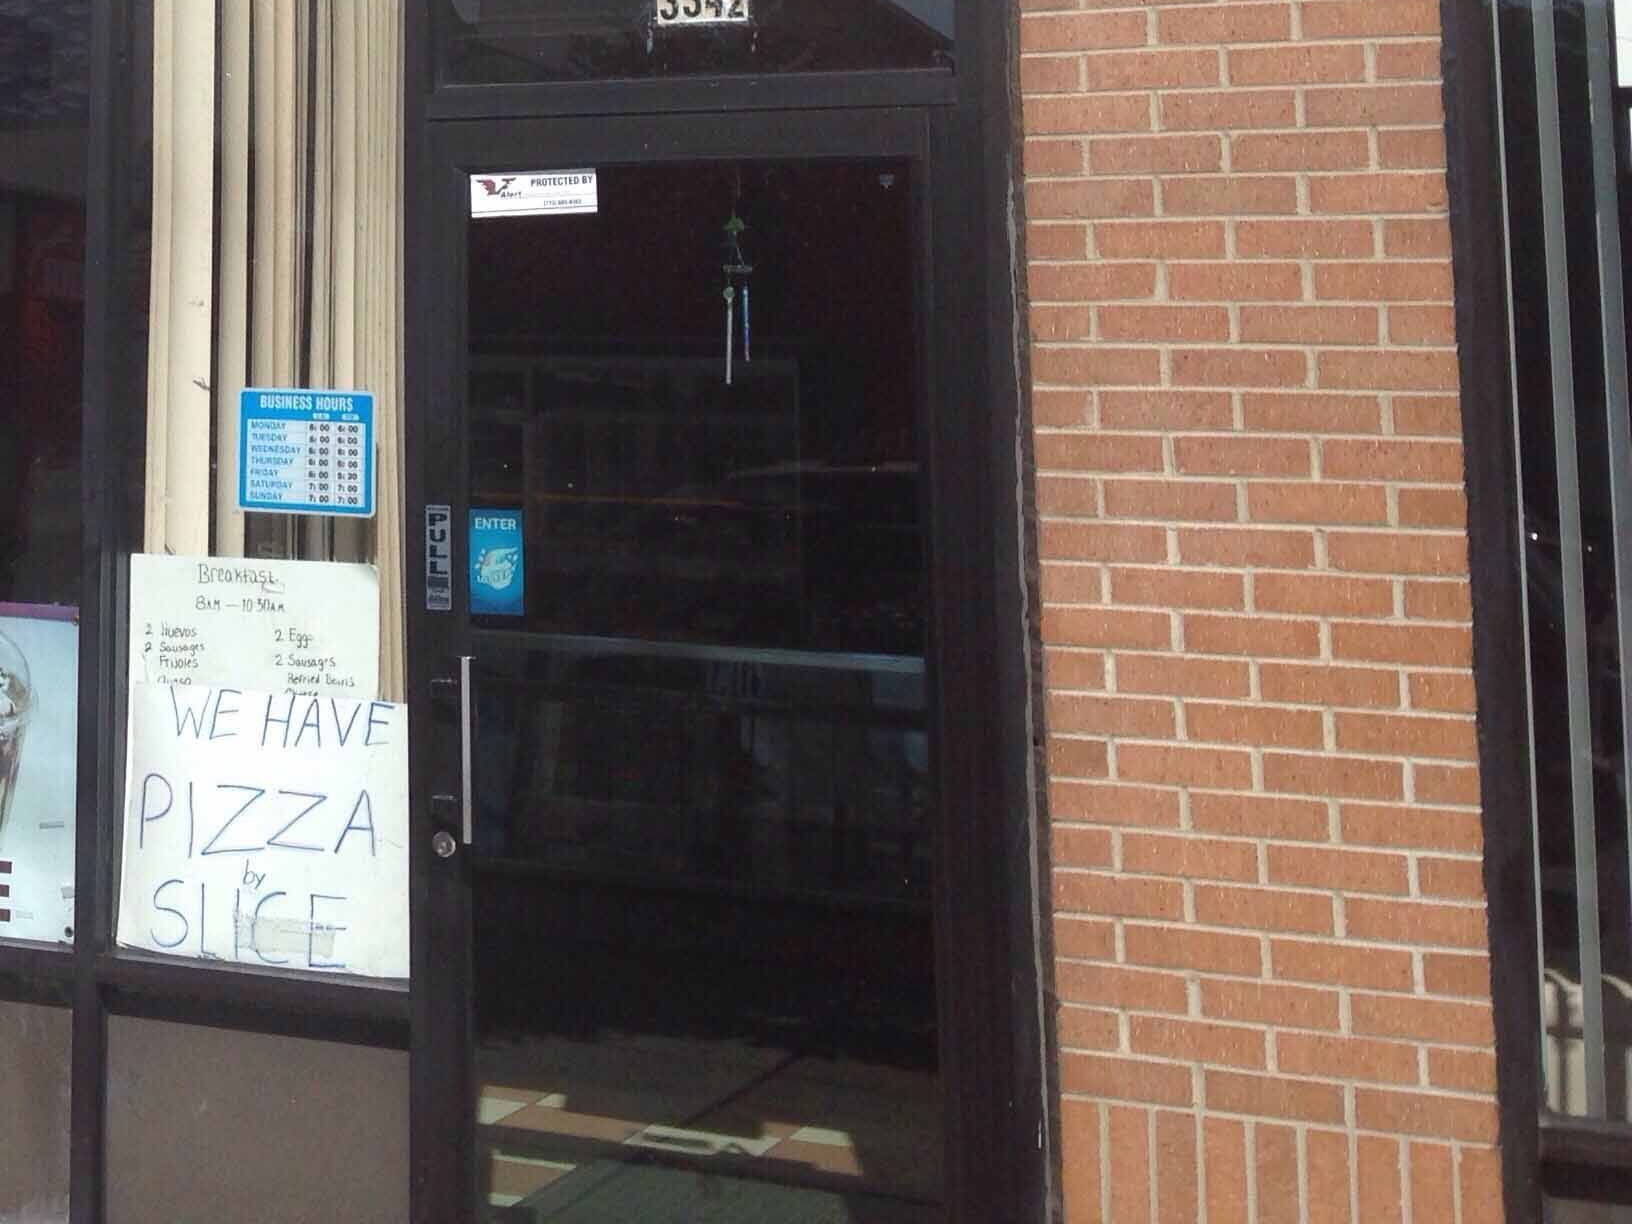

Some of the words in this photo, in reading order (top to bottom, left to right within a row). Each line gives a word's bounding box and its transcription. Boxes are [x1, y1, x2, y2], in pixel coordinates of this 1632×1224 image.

[530, 176, 580, 187] PROTECTED
[581, 175, 593, 184] BY
[259, 394, 312, 410] BUSINESS
[315, 397, 353, 412] HOURS
[251, 445, 301, 455] WEDNESDAY
[474, 517, 517, 530] ENTER
[429, 513, 448, 575] PULL
[274, 628, 284, 642] 2
[274, 654, 283, 667] 2
[170, 685, 243, 740] WE
[261, 695, 396, 748] HAVE
[139, 773, 377, 859] PIZZA
[243, 858, 267, 889] by
[149, 879, 348, 968] SLICE
